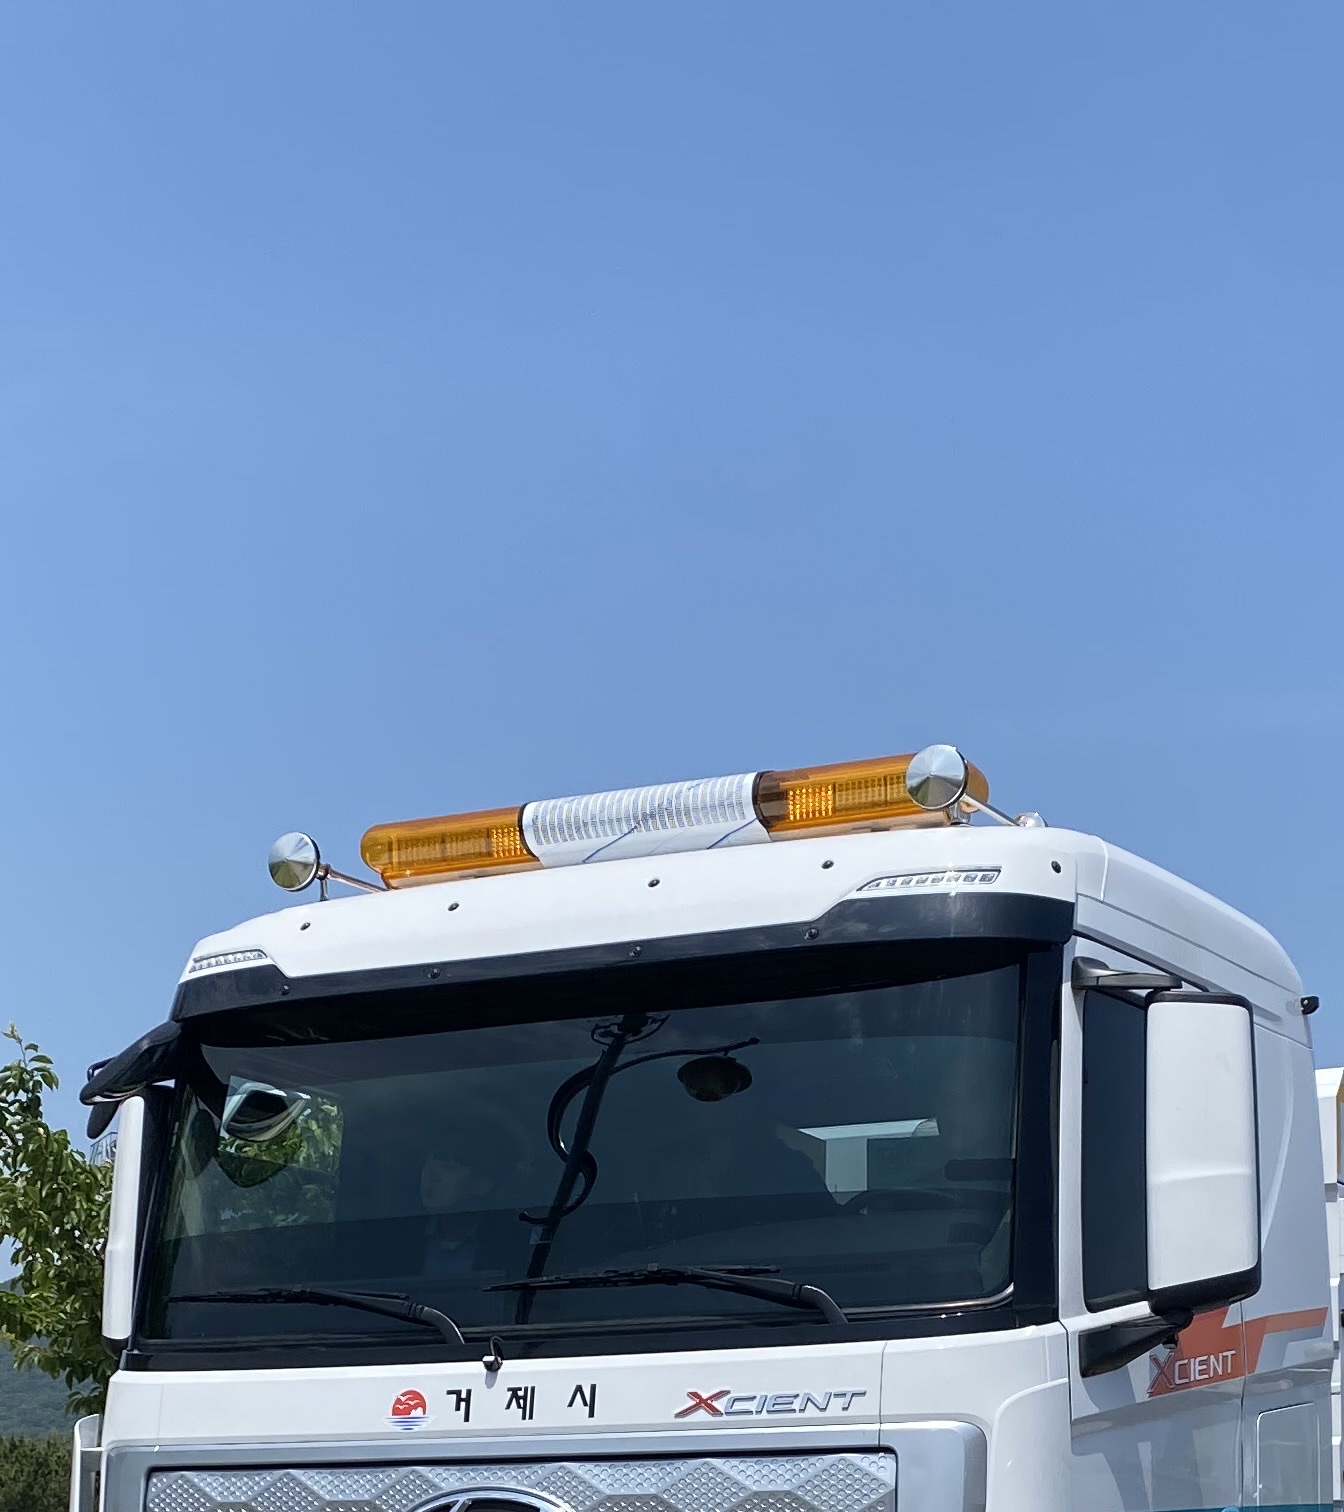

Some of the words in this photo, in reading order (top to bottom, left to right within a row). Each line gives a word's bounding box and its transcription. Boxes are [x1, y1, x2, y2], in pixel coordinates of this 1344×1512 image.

[1146, 1349, 1236, 1393] XCIENT
[446, 1383, 597, 1422] 거제시
[674, 1388, 867, 1418] XCIENT
